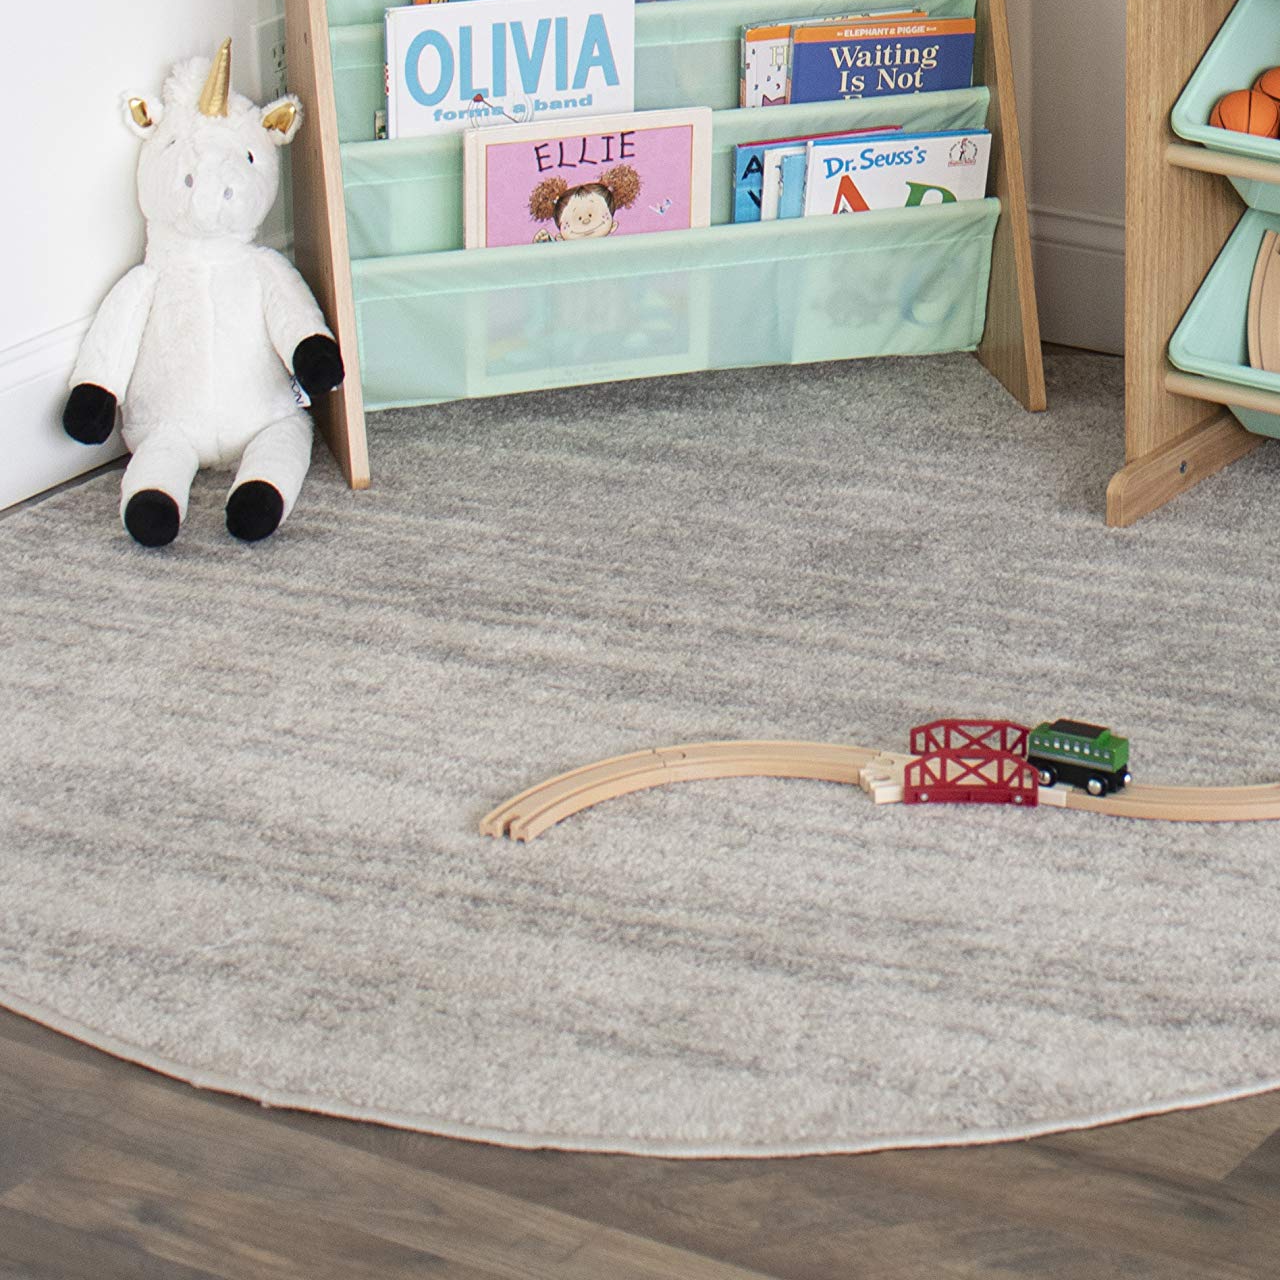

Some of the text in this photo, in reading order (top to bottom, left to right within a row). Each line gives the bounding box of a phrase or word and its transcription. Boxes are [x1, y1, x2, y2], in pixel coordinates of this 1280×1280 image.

[844, 27, 889, 38] ELEPHANT
[889, 27, 896, 35] &
[897, 25, 925, 34] PIGGIE
[404, 13, 620, 107] OLIVIA
[829, 42, 940, 70] Waiting
[839, 67, 925, 93] Is Not
[433, 93, 593, 122] forms a band
[534, 131, 636, 173] ELLIE
[823, 157, 857, 180] Dr.
[860, 145, 928, 170] Seuss's
